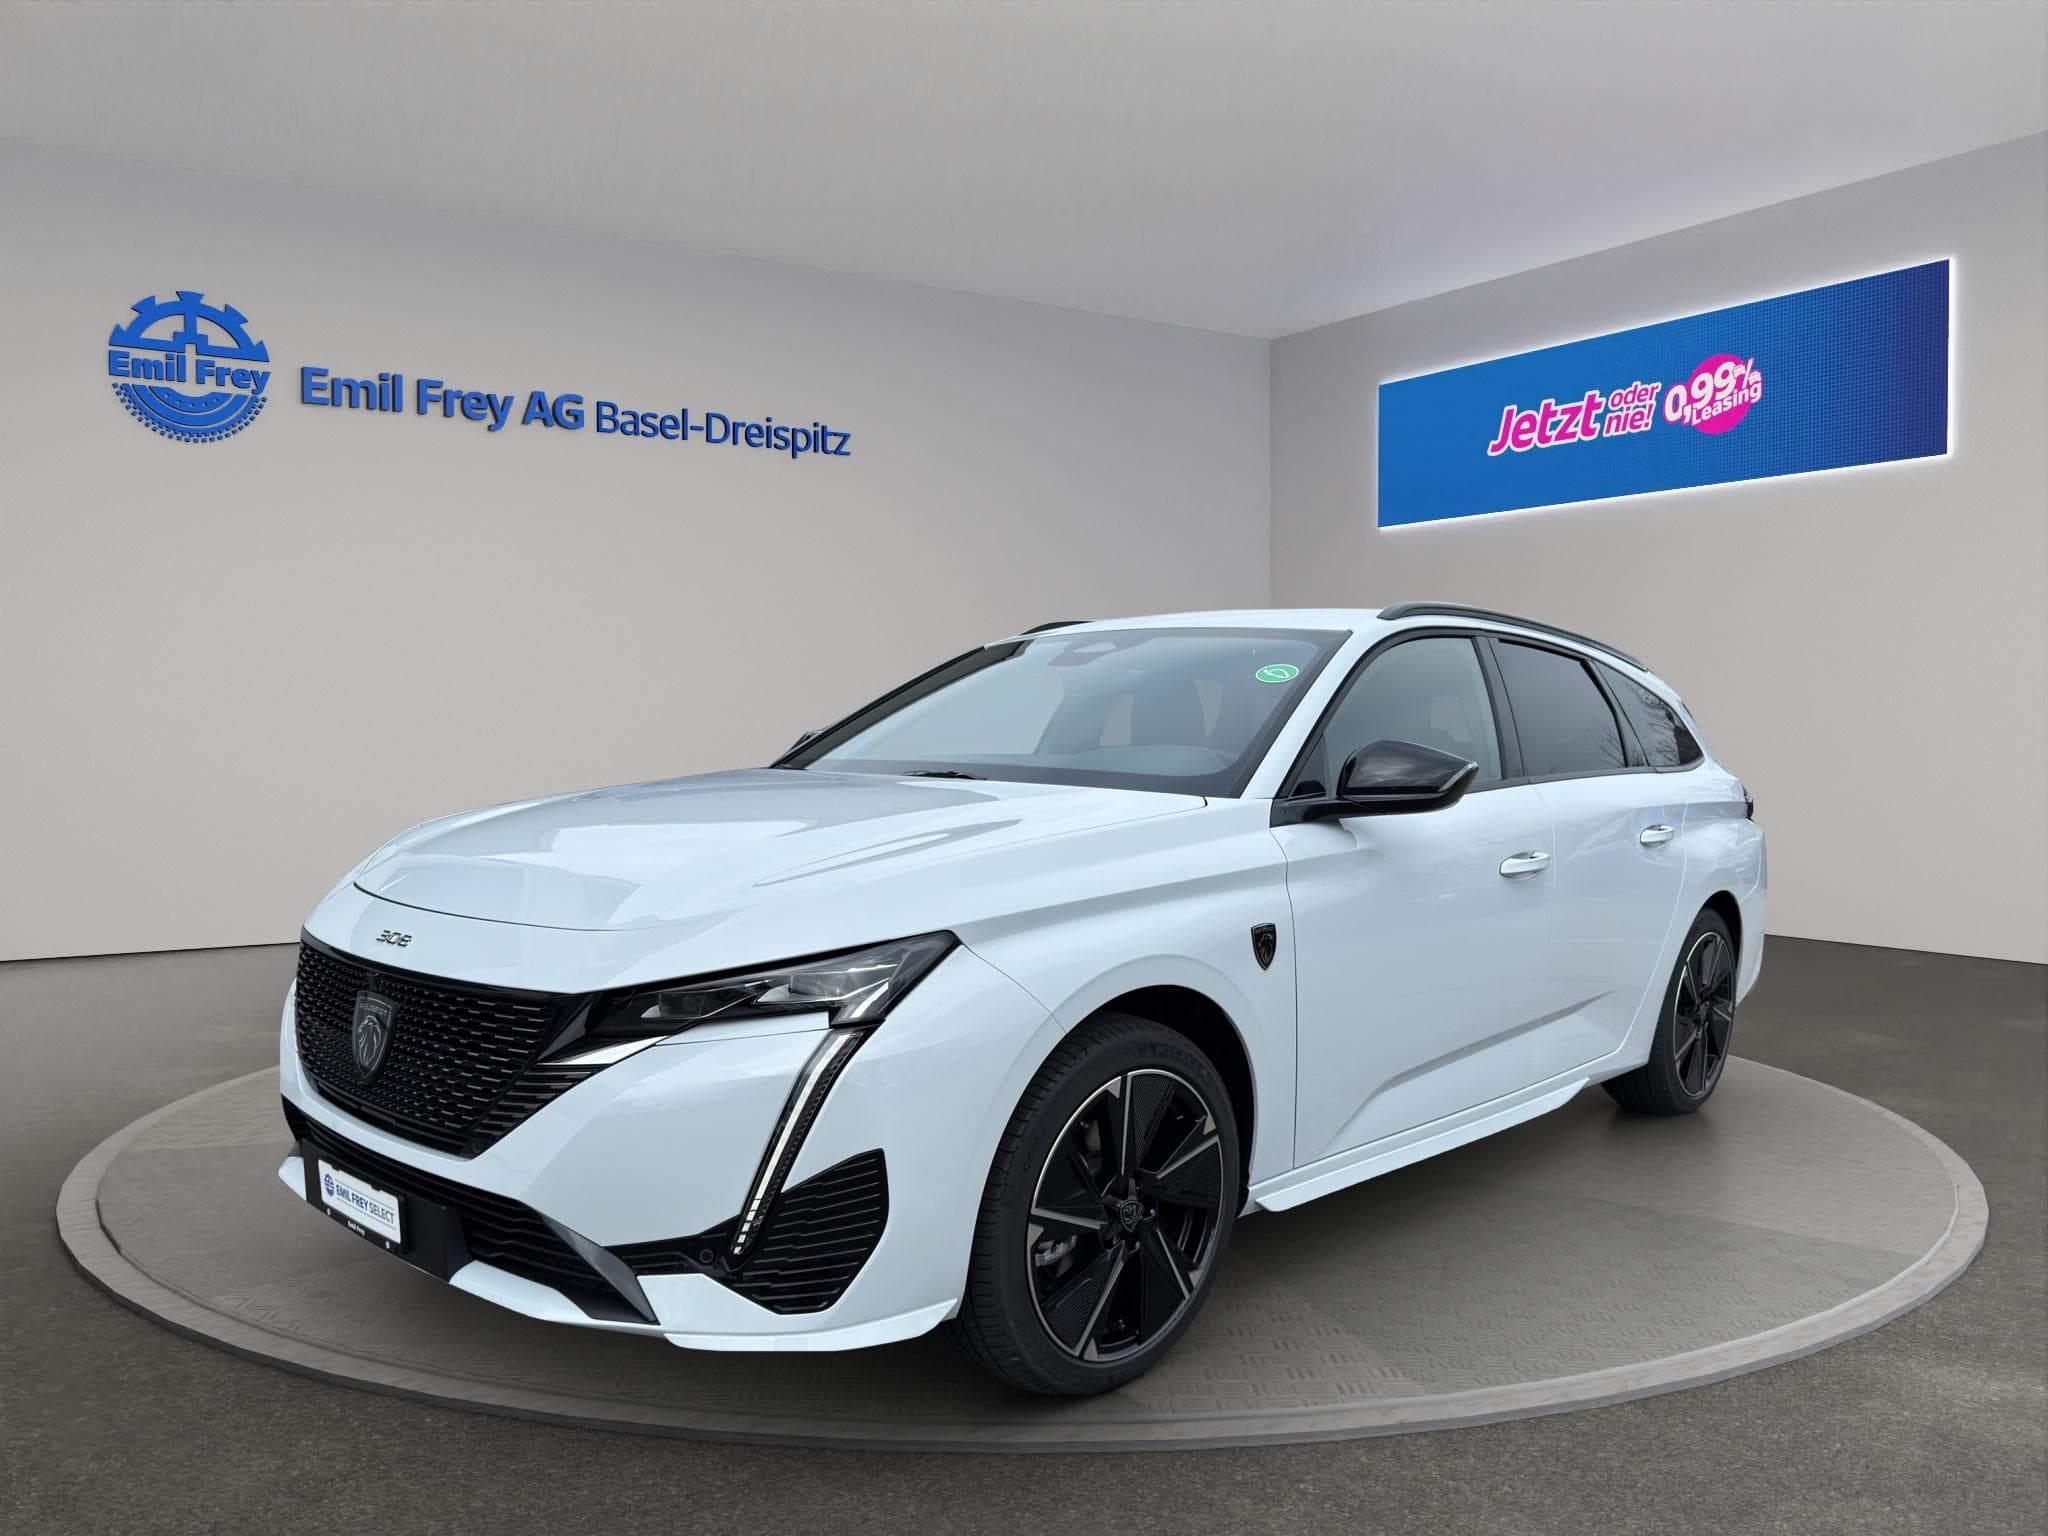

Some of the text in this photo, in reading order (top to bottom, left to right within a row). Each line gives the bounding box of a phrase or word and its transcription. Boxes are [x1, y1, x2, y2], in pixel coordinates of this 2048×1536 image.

[109, 350, 271, 394] Emil Frey
[1664, 358, 1762, 424] 0,99%
[301, 366, 852, 458] Emil Frey AG Basel-Dreispitz
[1609, 382, 1660, 410] oder
[1691, 382, 1762, 426] Leasing
[1488, 390, 1604, 456] Jetzt
[1604, 400, 1652, 437] nie!
[376, 929, 413, 948] 308
[336, 1185, 395, 1224] EMIL FREY SELECT
